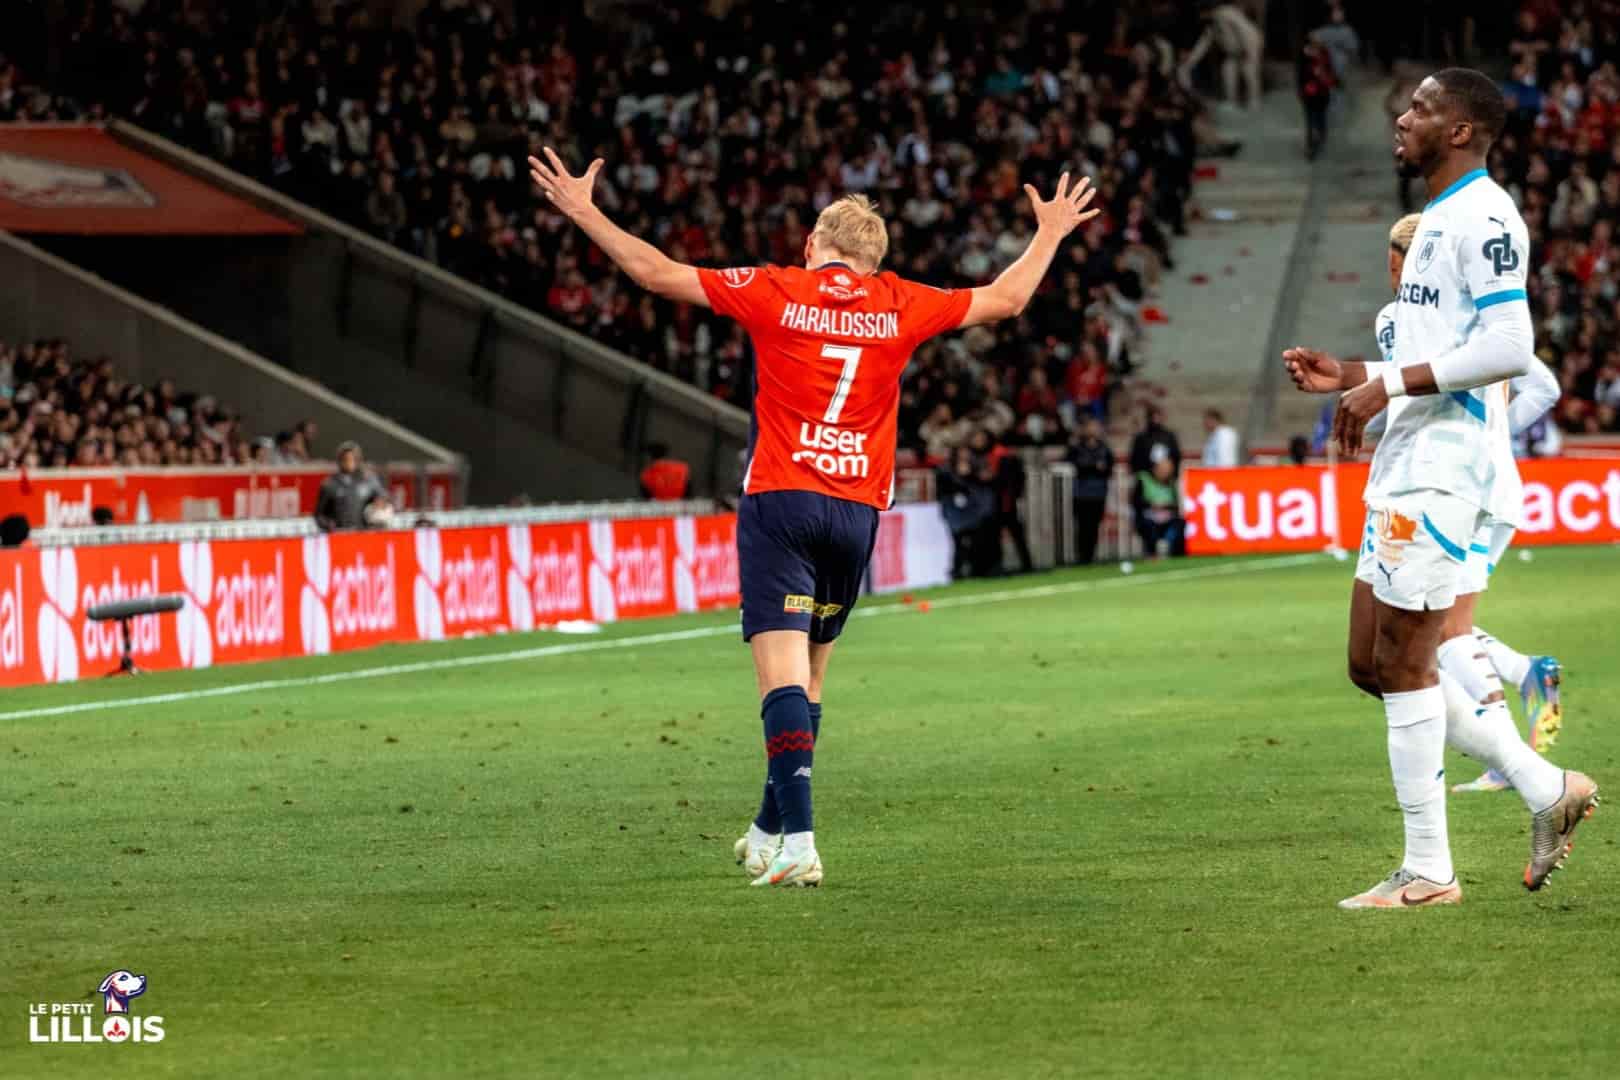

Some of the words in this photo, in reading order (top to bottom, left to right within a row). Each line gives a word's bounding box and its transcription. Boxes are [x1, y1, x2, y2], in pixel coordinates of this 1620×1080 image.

[780, 302, 898, 338] HARALDSSON
[820, 343, 863, 424] 7
[799, 422, 867, 453] user
[215, 548, 284, 647] actual
[332, 541, 397, 635] actual
[443, 533, 500, 623] actual
[533, 530, 582, 613] actual
[616, 527, 666, 606] actual
